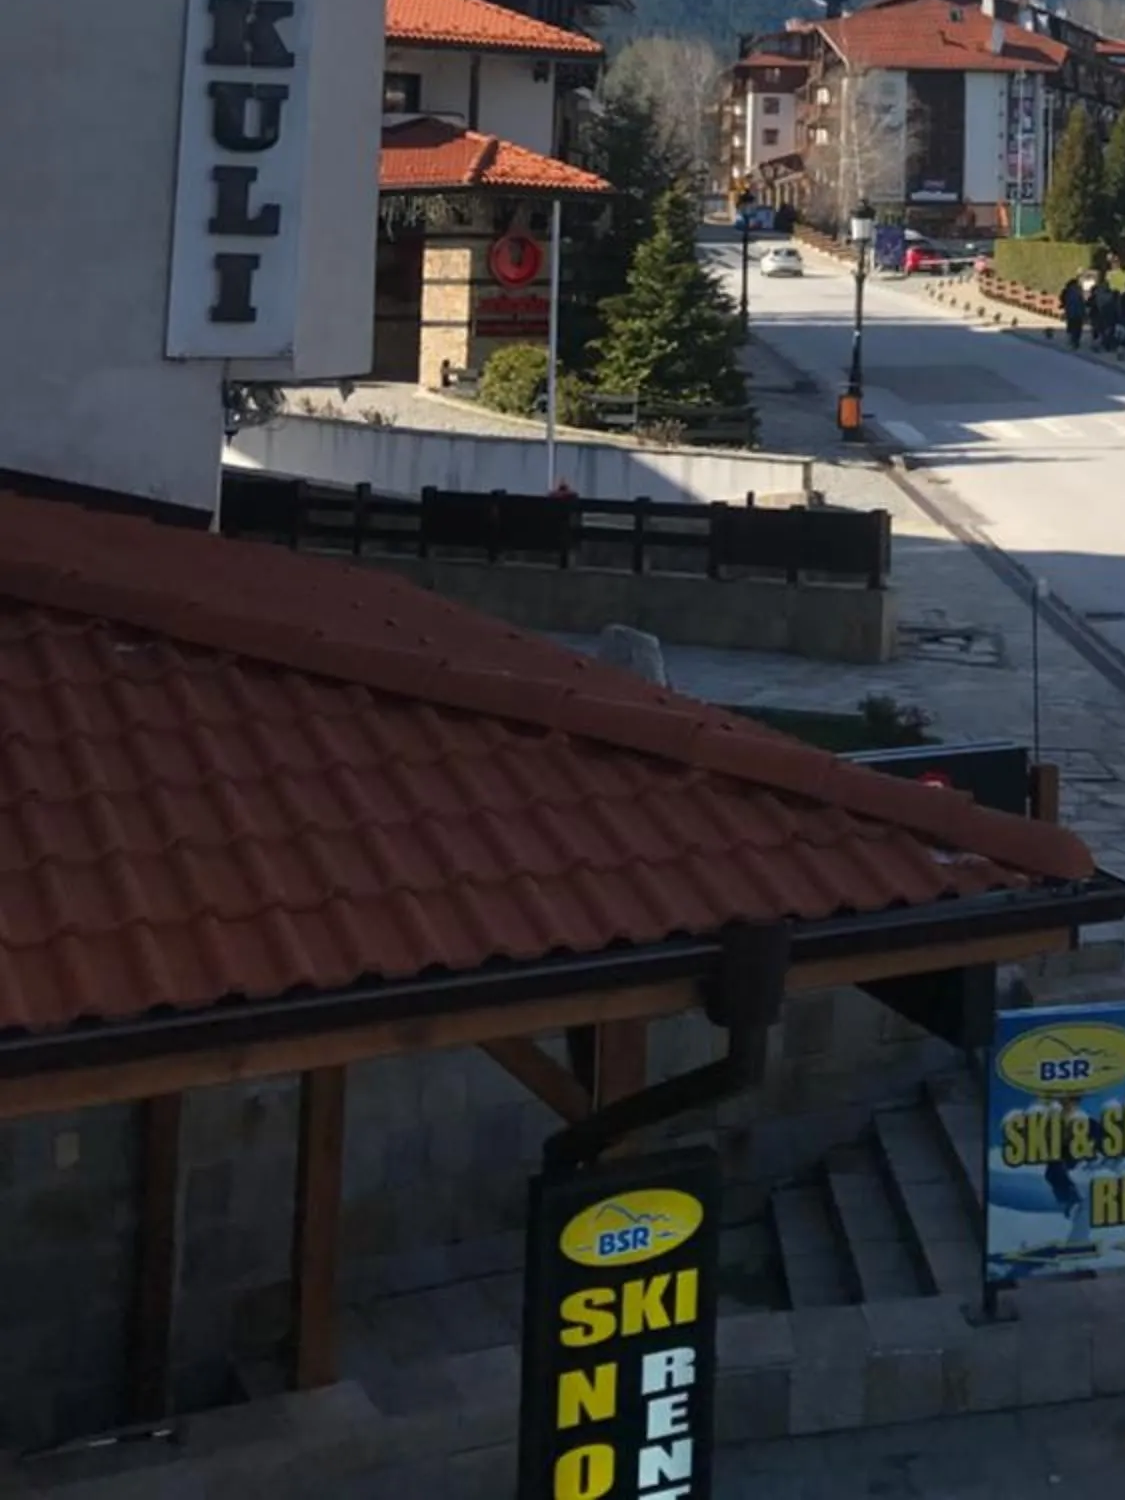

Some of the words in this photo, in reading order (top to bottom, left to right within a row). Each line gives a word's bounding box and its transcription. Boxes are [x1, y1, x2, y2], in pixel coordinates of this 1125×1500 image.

[1039, 1058, 1091, 1082] BSR
[1003, 1102, 1062, 1167] SKI
[1068, 1111, 1095, 1162] &
[598, 1226, 650, 1256] BSR
[560, 1267, 699, 1348] SKI
